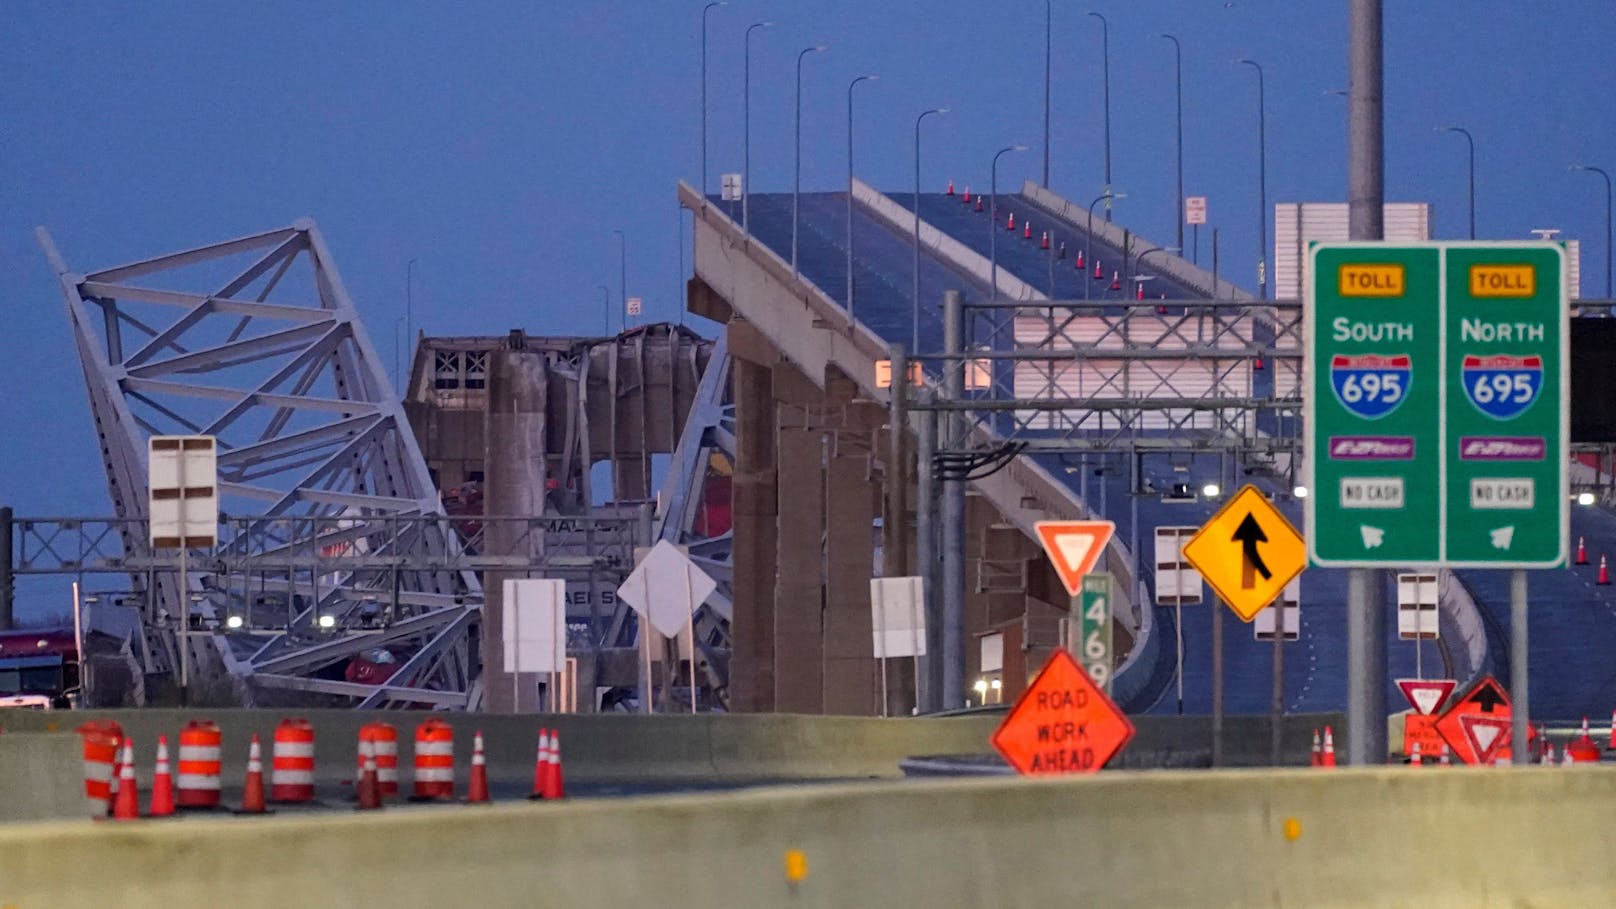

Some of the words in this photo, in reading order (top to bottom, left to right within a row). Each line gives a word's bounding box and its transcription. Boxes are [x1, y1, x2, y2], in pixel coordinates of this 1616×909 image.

[1348, 272, 1396, 289] TOLL
[1477, 273, 1527, 289] TOLL
[1332, 316, 1414, 342] SOUTH
[1461, 317, 1544, 342] NORTH
[1341, 373, 1402, 403] 695
[1473, 374, 1533, 404] 695
[1346, 485, 1363, 500] NO
[1367, 485, 1400, 500] CASH
[1476, 486, 1493, 501] NO
[1498, 486, 1530, 501] CASH
[1037, 687, 1088, 712] ROAD
[1038, 721, 1088, 743] WORK
[1030, 746, 1094, 773] AHEAD
